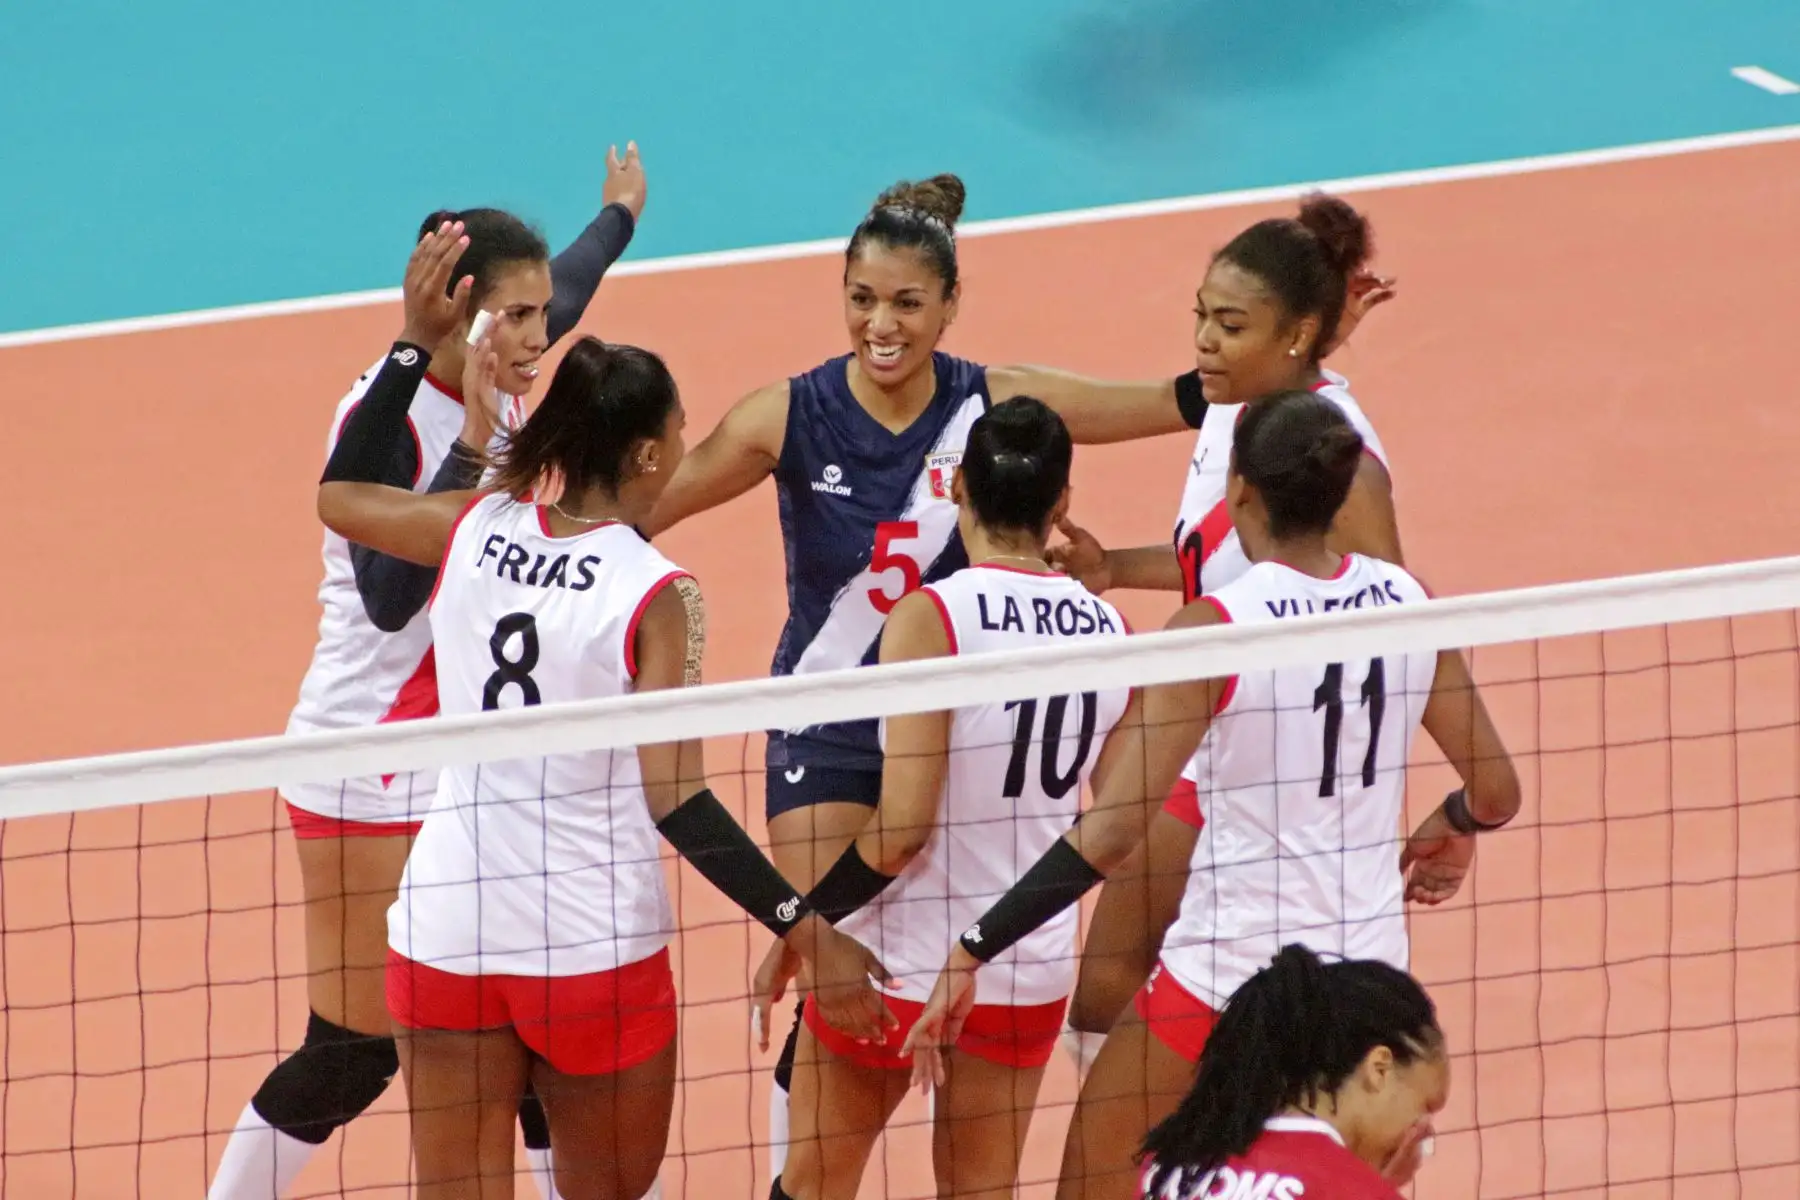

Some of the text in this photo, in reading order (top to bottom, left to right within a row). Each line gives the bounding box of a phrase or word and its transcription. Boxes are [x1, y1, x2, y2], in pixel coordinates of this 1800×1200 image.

[811, 480, 852, 497] WALON
[931, 455, 960, 467] PERU
[476, 533, 603, 592] FRIAS
[866, 520, 921, 616] 5
[976, 592, 1117, 637] LA ROSA
[481, 611, 542, 712] 8
[1002, 690, 1098, 800] 10
[1312, 656, 1387, 798] 11
